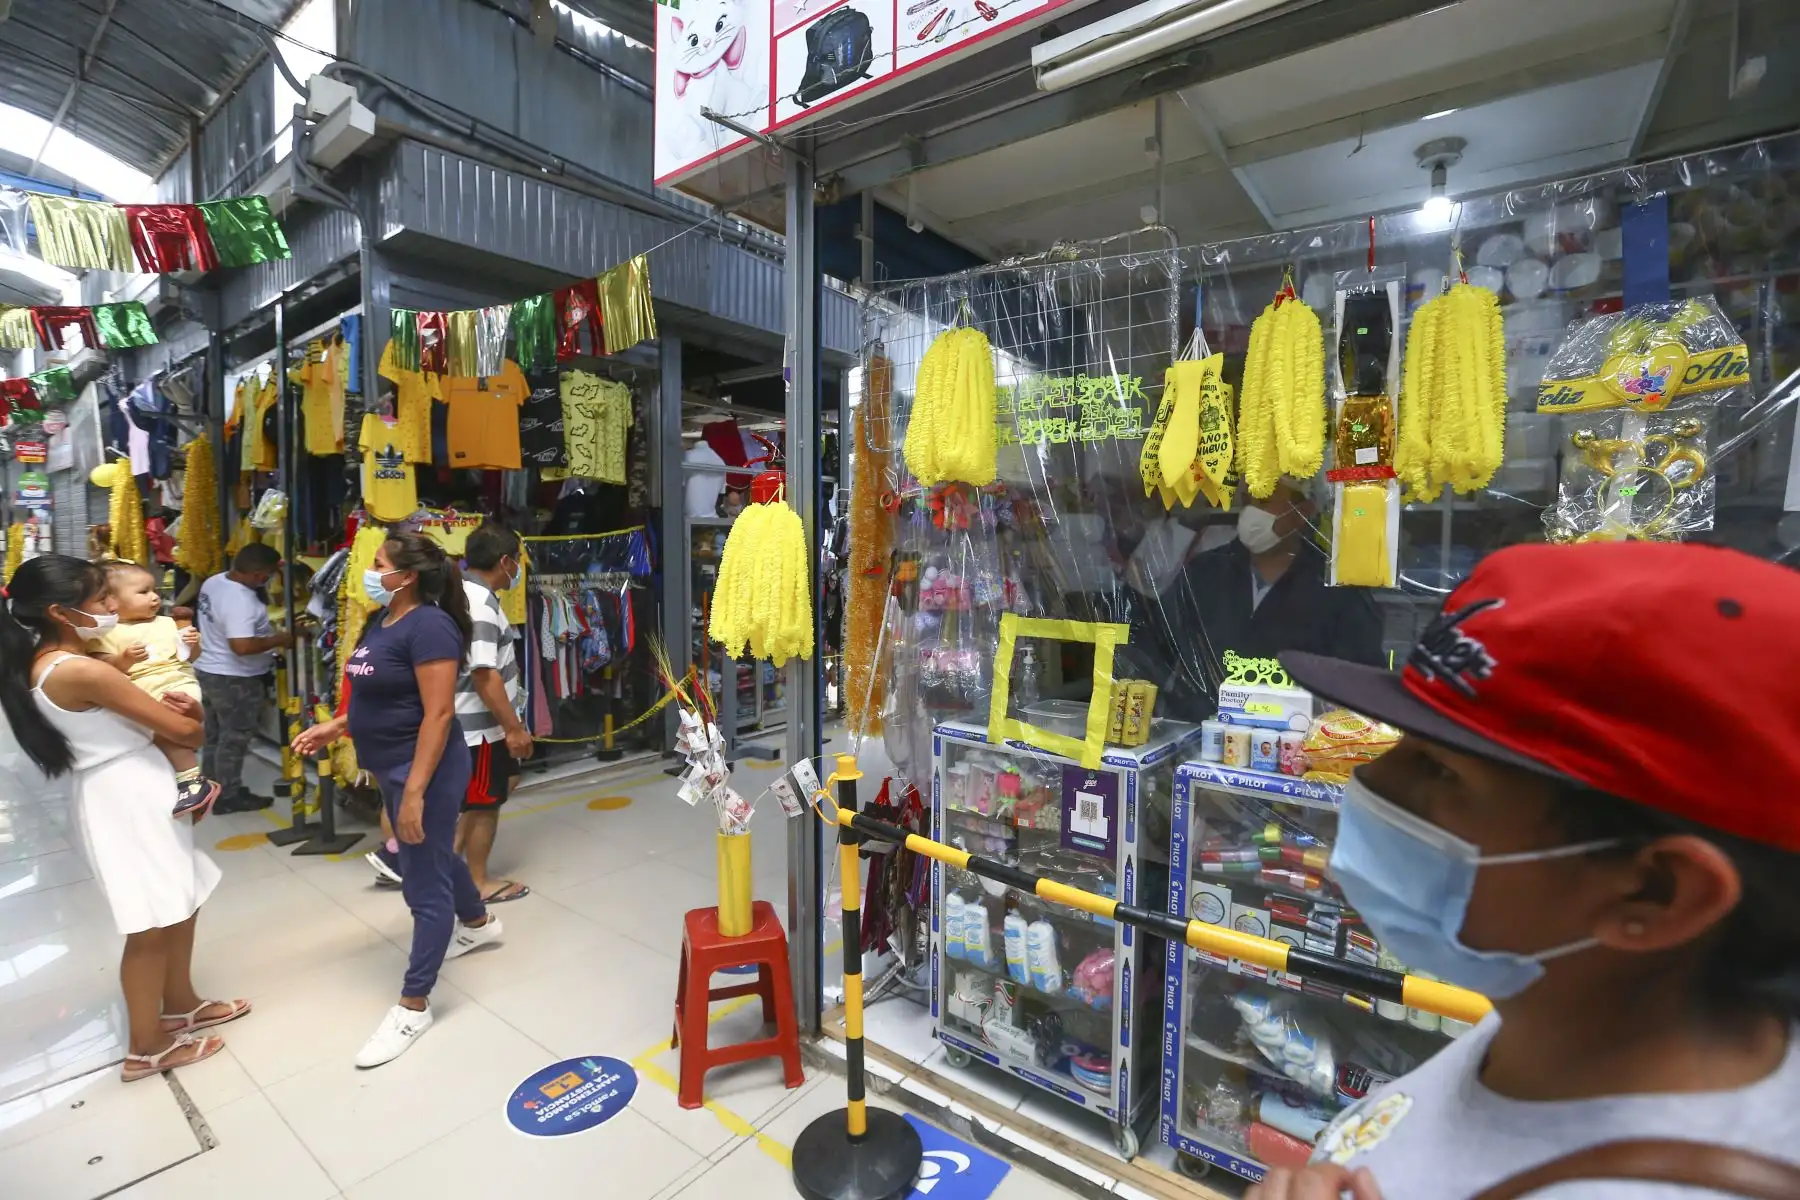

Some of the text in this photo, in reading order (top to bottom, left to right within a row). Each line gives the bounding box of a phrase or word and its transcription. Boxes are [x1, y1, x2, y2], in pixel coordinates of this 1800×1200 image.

[1682, 351, 1749, 385] Añ
[1199, 433, 1222, 446] AÑO
[1220, 689, 1250, 701] Family
[1220, 696, 1244, 704] Doctor
[1186, 769, 1214, 781] PILOT
[1238, 778, 1267, 789] PILOT
[1294, 786, 1325, 799] PILOT
[1174, 793, 1182, 820] PILOT
[1172, 842, 1180, 868] PILOT
[1170, 890, 1179, 915] PILOT
[1166, 985, 1174, 1010] PILOT
[1165, 1031, 1173, 1056] PILOT
[593, 1072, 609, 1085] LA
[535, 1082, 594, 1116] DISTANCIA
[537, 1073, 621, 1123] MANTENGAMOS
[1163, 1078, 1172, 1102] PILOT
[1190, 1146, 1216, 1161] PILOT
[1241, 1168, 1264, 1181] PILO
